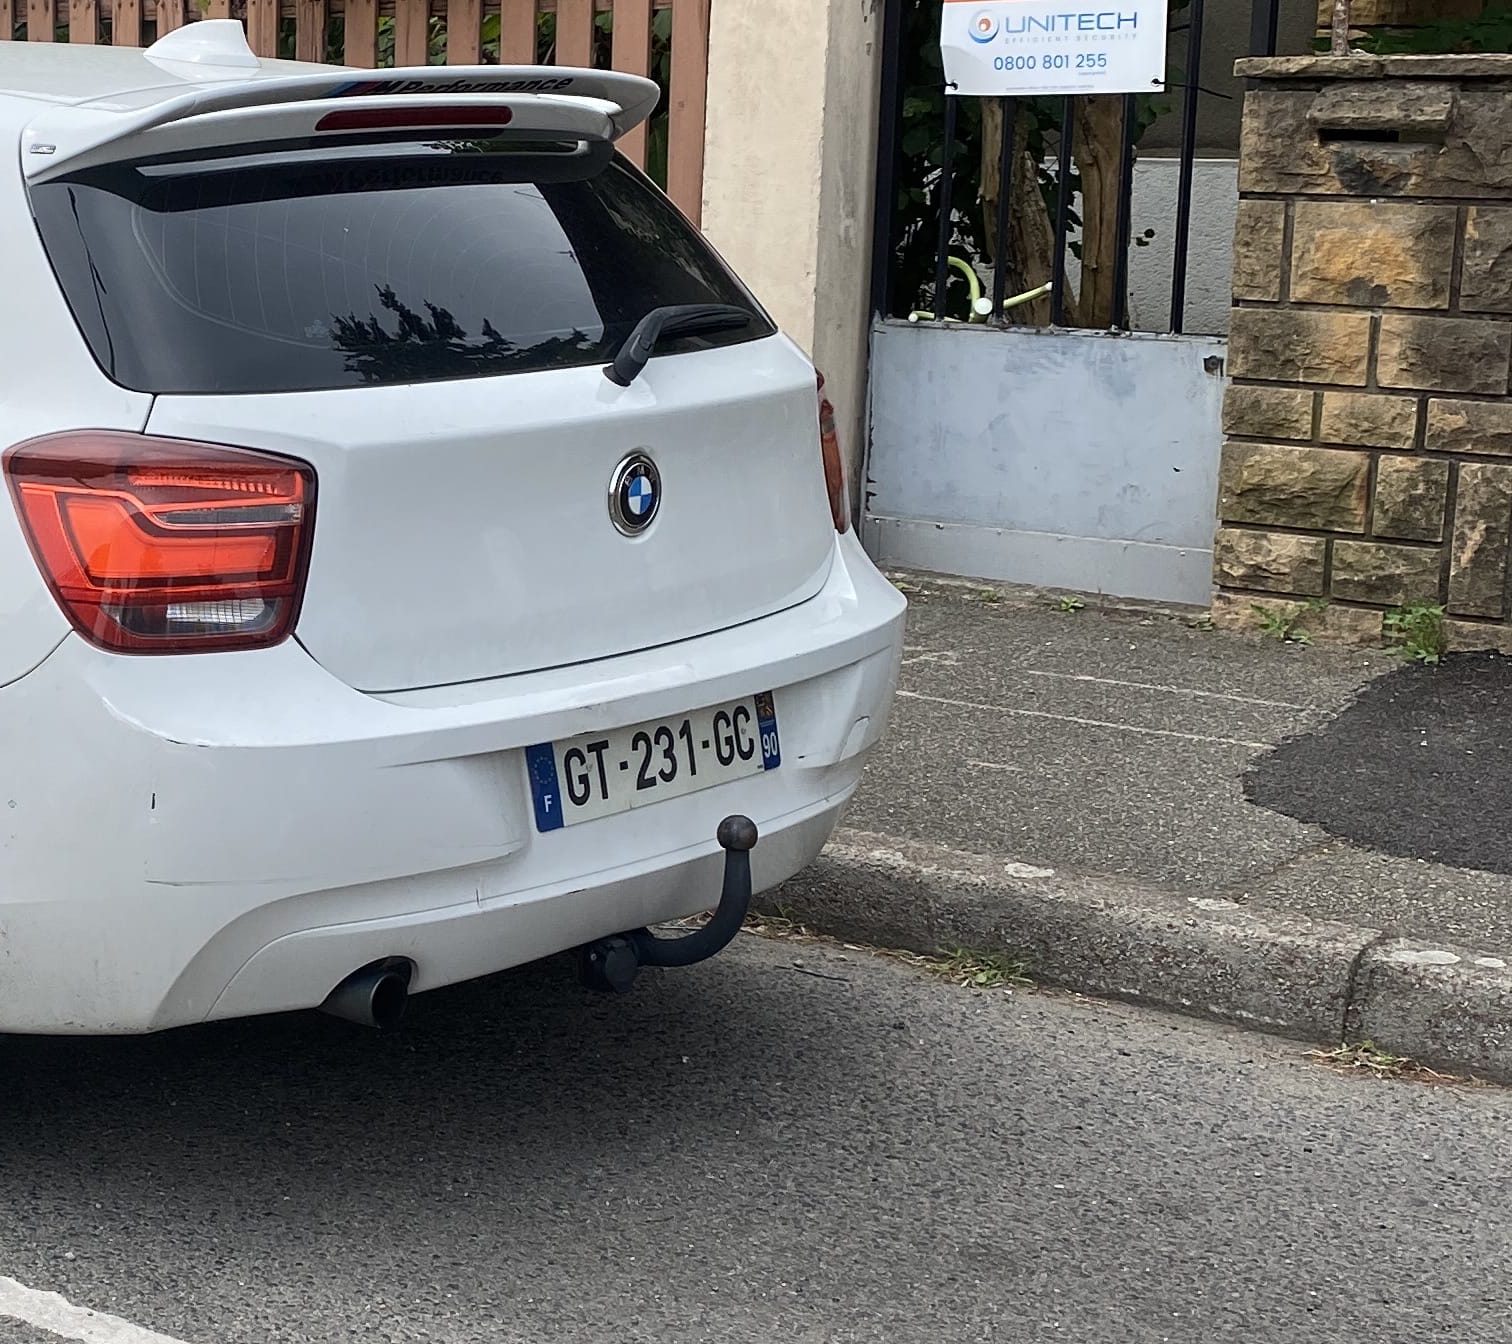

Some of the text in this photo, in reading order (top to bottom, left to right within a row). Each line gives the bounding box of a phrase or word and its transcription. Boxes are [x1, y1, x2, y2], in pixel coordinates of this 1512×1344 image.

[1005, 11, 1138, 33] UNITECH
[994, 53, 1107, 70] 0800 801 255
[399, 77, 574, 94] Performance
[543, 705, 778, 813] F GT-231-GC 90
